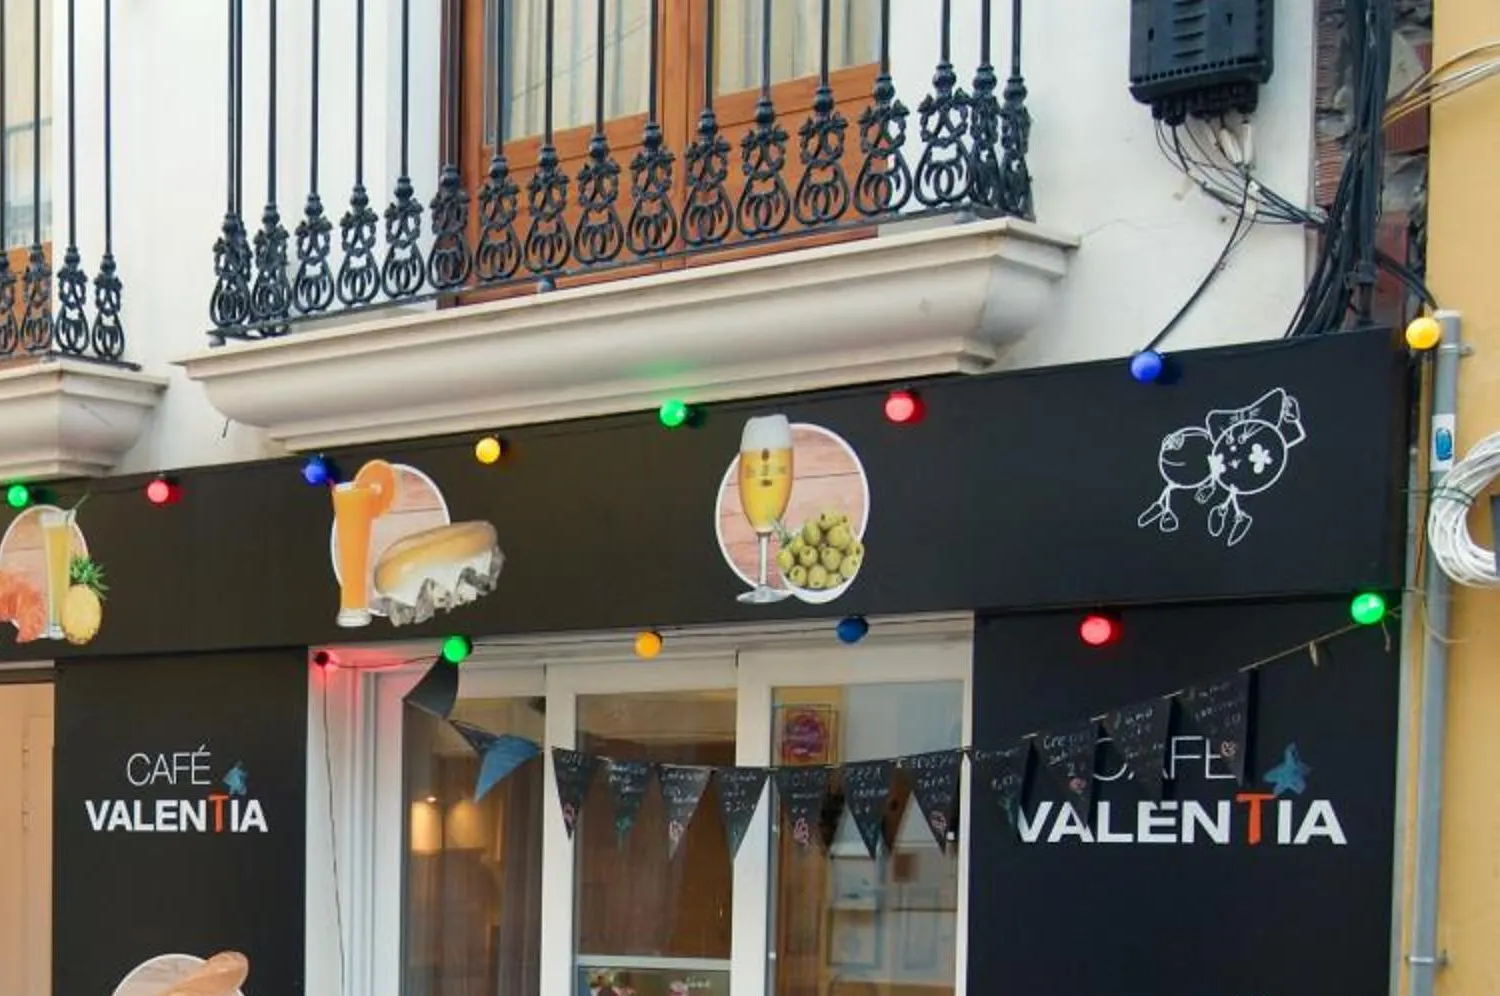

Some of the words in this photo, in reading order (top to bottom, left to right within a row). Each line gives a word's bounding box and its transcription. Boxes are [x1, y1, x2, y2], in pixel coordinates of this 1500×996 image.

[125, 743, 212, 787] CAFÉ
[84, 793, 270, 833] VALENTIA
[1016, 792, 1348, 846] VALENTIA
